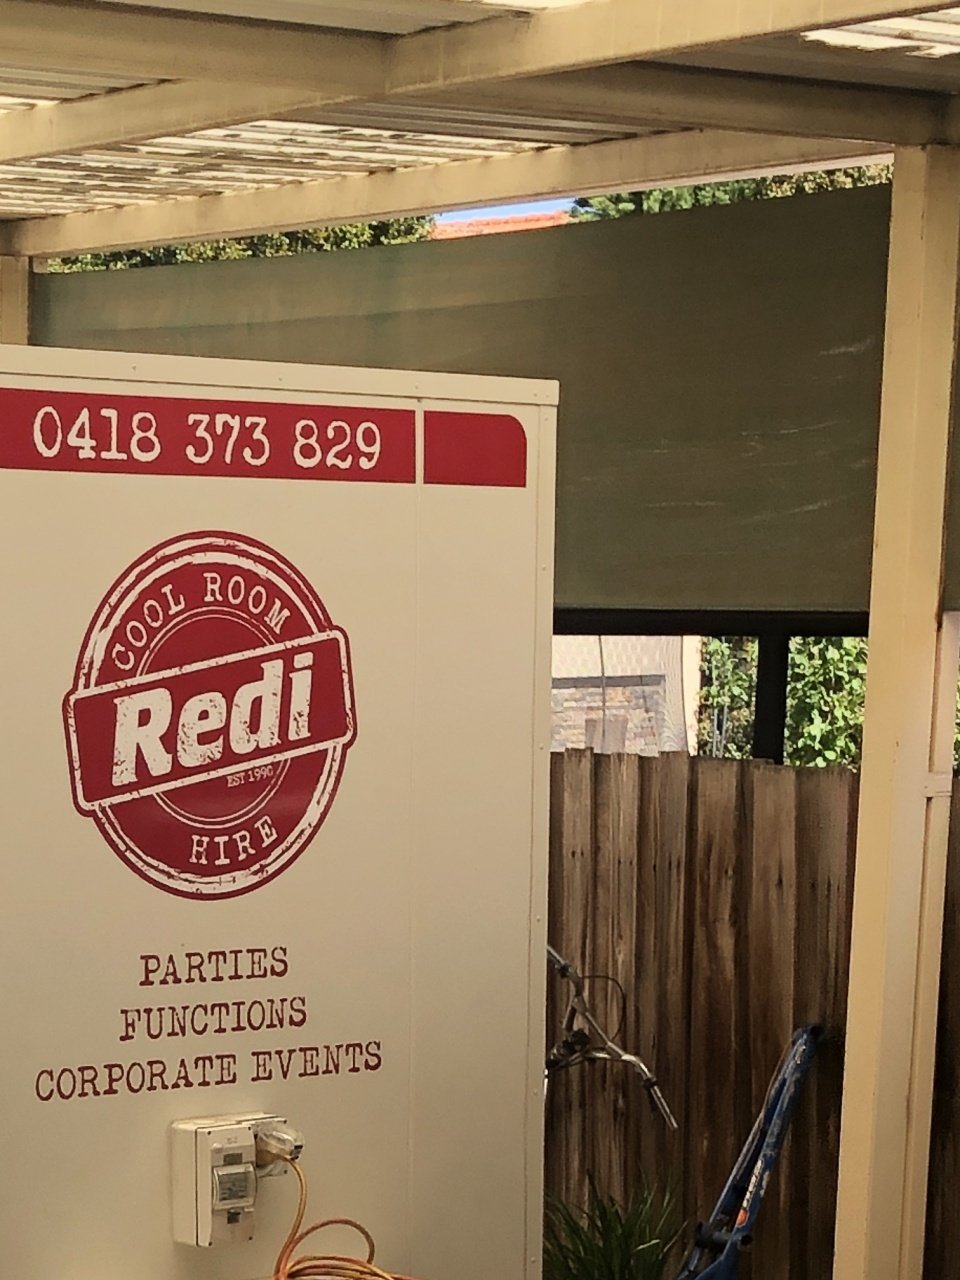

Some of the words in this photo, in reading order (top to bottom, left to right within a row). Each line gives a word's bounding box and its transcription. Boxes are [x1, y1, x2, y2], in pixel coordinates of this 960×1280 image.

[33, 407, 161, 462] 0418
[185, 412, 271, 466] 373
[292, 419, 381, 469] 829
[111, 584, 186, 671] COOL
[204, 572, 292, 635] ROOM
[111, 652, 314, 787] Redi
[226, 772, 245, 787] EST
[189, 816, 278, 865] HIRE
[138, 946, 289, 987] PARTIES
[119, 996, 308, 1042] FUNCTIONS
[35, 1053, 237, 1101] CORPORATE
[251, 1040, 382, 1082] EVENTS
